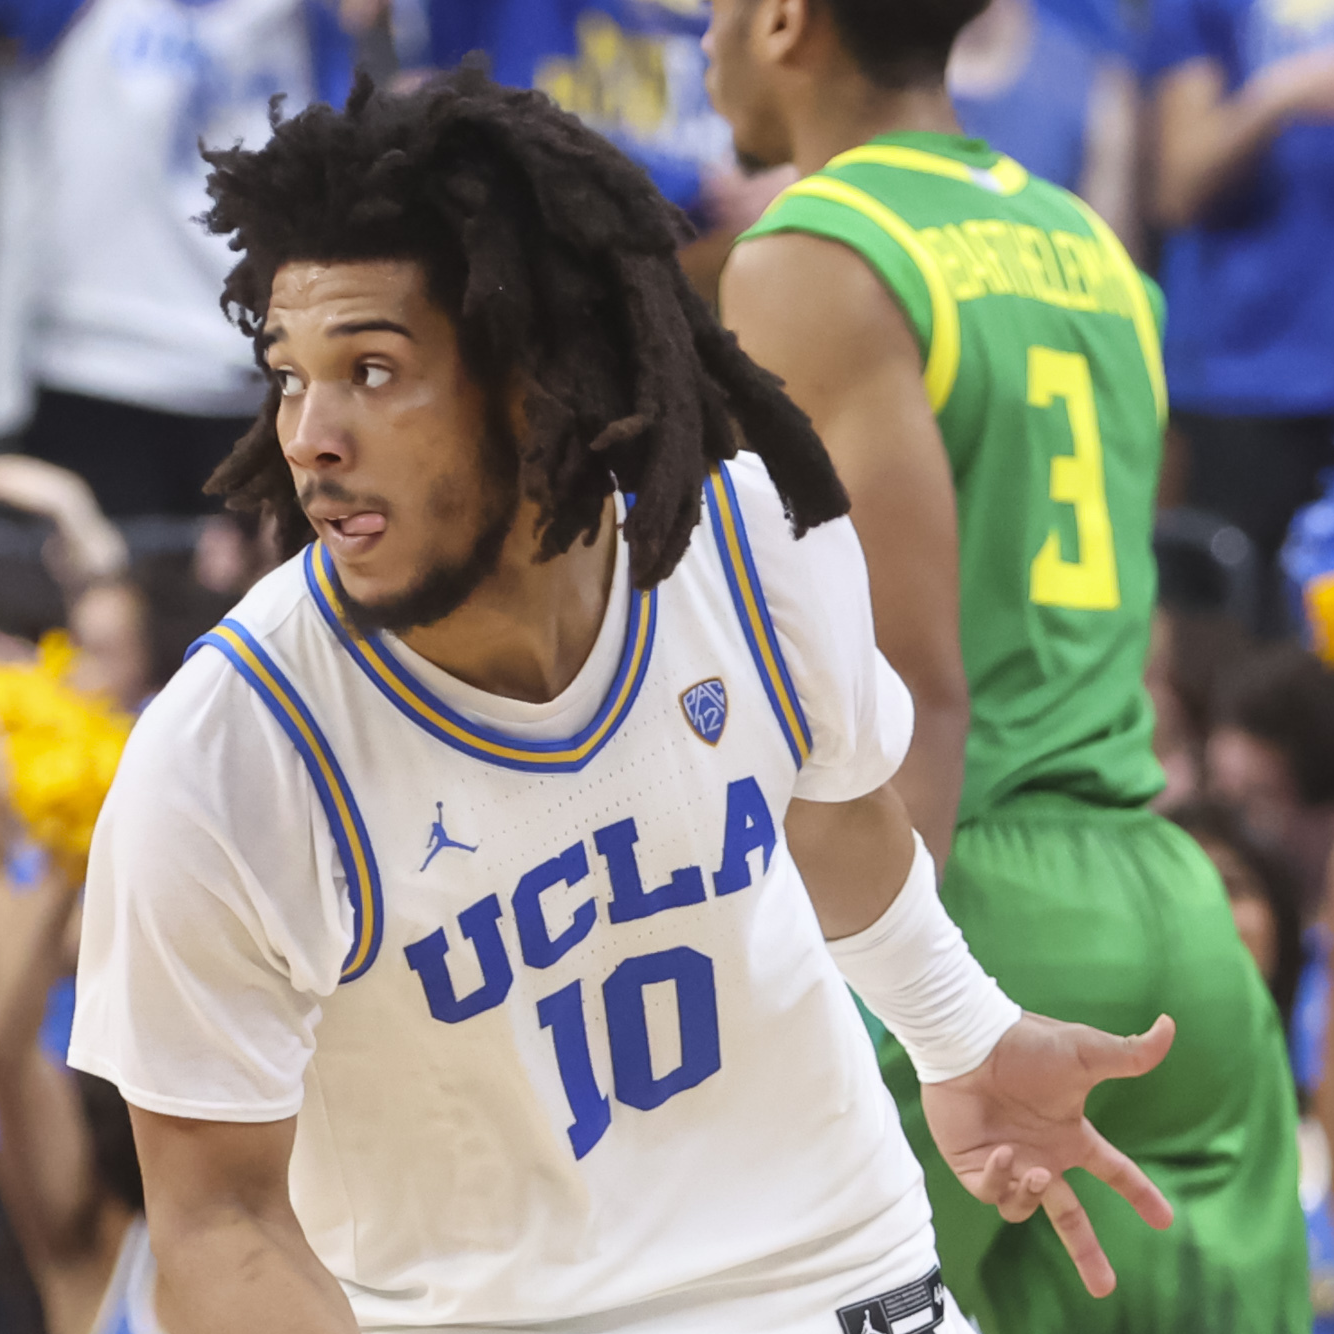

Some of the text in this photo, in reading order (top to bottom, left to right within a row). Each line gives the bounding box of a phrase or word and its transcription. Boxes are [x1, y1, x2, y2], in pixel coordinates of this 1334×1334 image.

[1025, 345, 1121, 610] 3
[683, 680, 725, 726] PAC
[698, 707, 721, 734] 12
[403, 776, 777, 1024] UCLA
[536, 946, 722, 1161] 10
